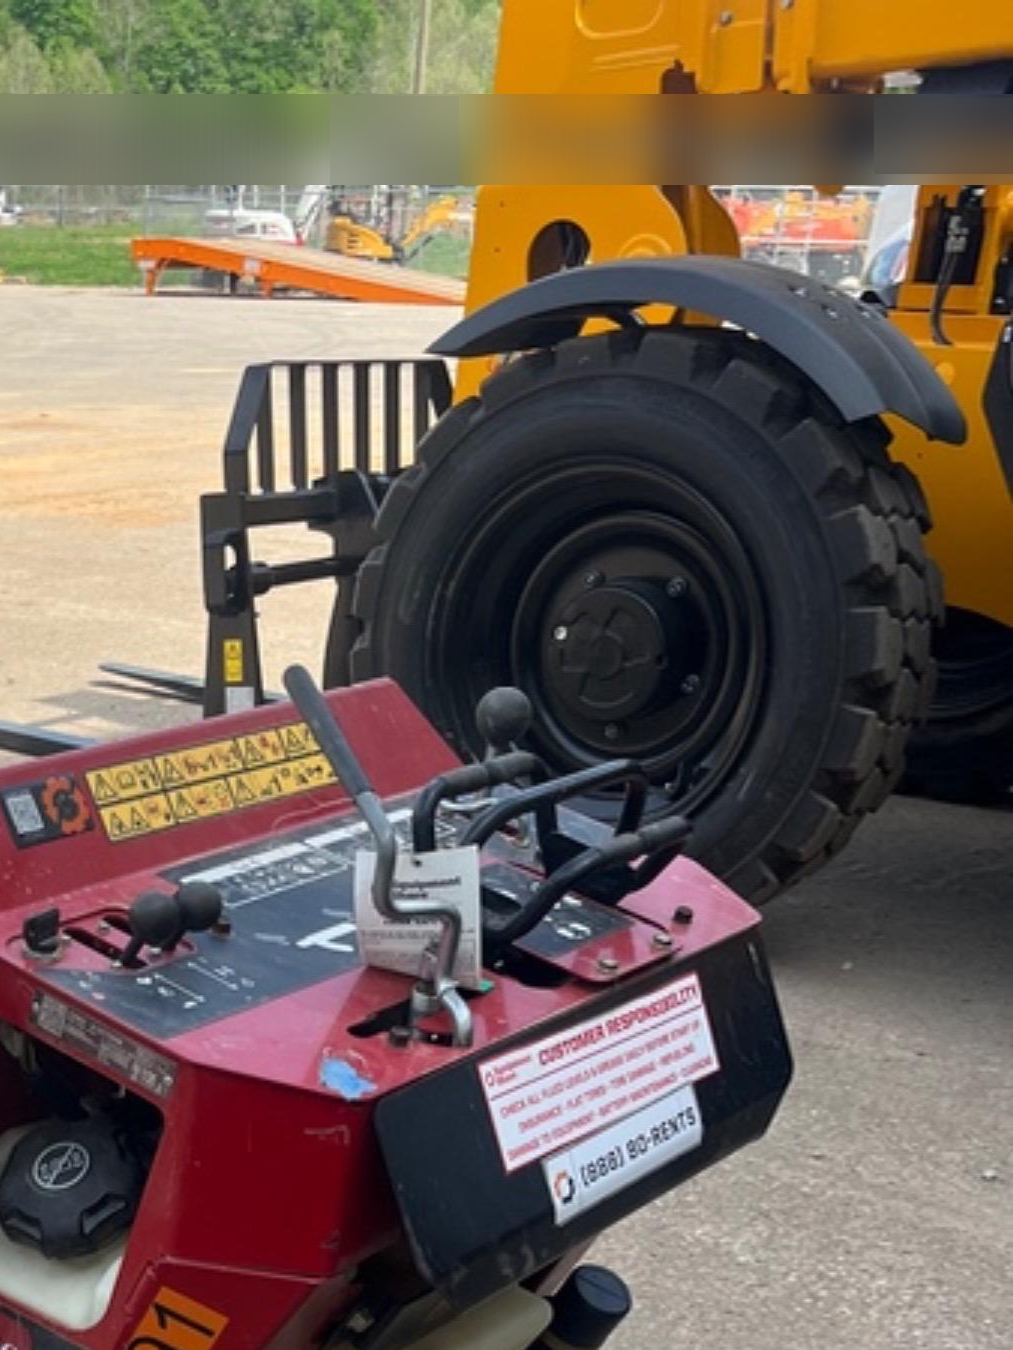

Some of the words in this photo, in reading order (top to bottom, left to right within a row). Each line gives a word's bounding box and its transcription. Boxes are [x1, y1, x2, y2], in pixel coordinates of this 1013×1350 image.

[539, 1028, 606, 1065] CUSTOMER
[606, 987, 697, 1033] RESPONSIBILITY
[581, 1147, 625, 1186] (888)
